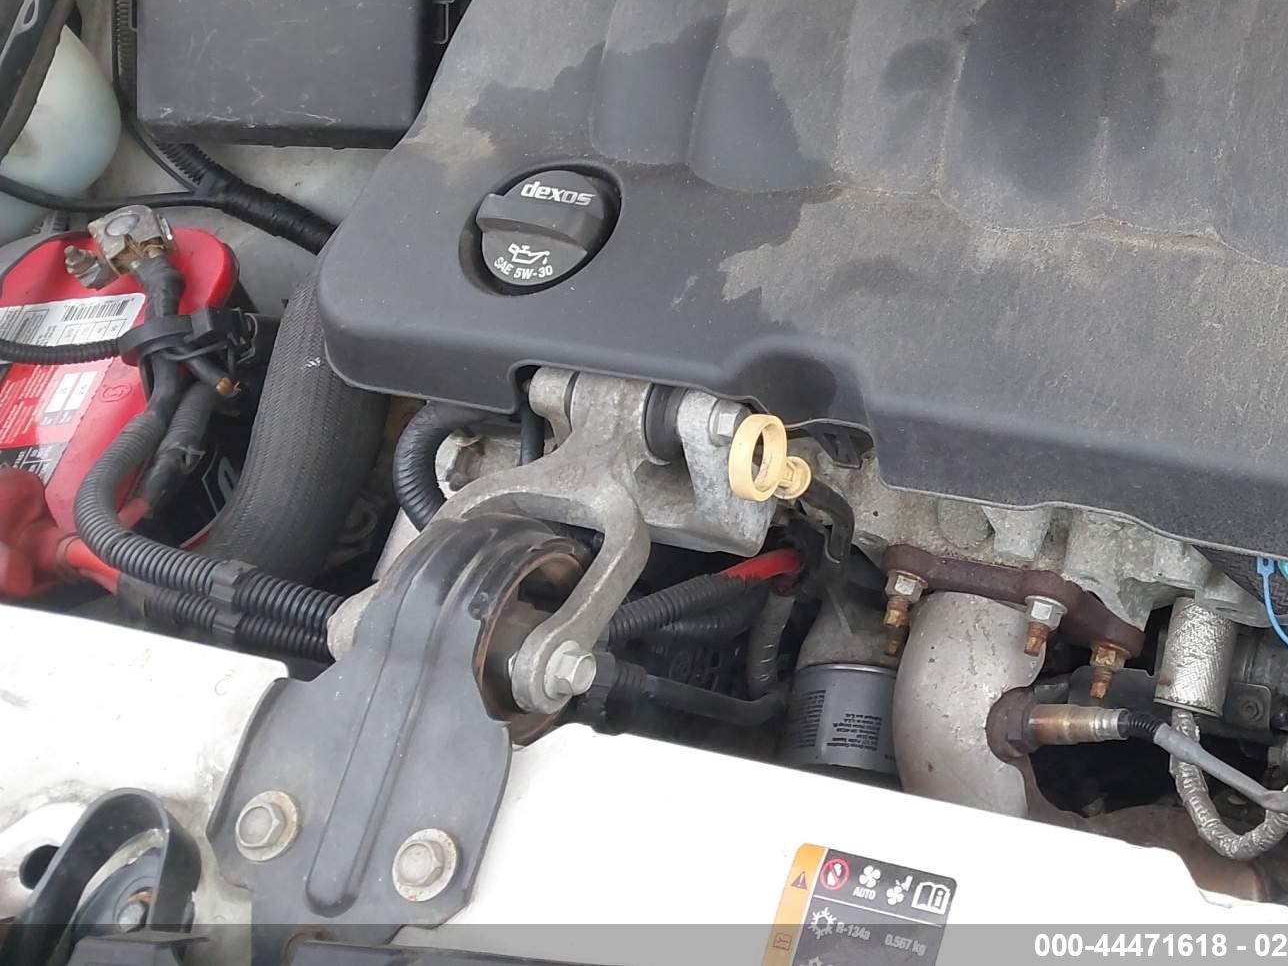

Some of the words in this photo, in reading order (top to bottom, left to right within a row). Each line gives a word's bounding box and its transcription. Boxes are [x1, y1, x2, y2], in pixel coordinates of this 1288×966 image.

[520, 181, 596, 206] dexos
[494, 256, 513, 276] SAE
[514, 264, 553, 280] 5W-30
[852, 886, 876, 900] AUTO
[836, 921, 870, 940] R-134a
[884, 934, 911, 951] 0.567
[911, 940, 927, 956] kg
